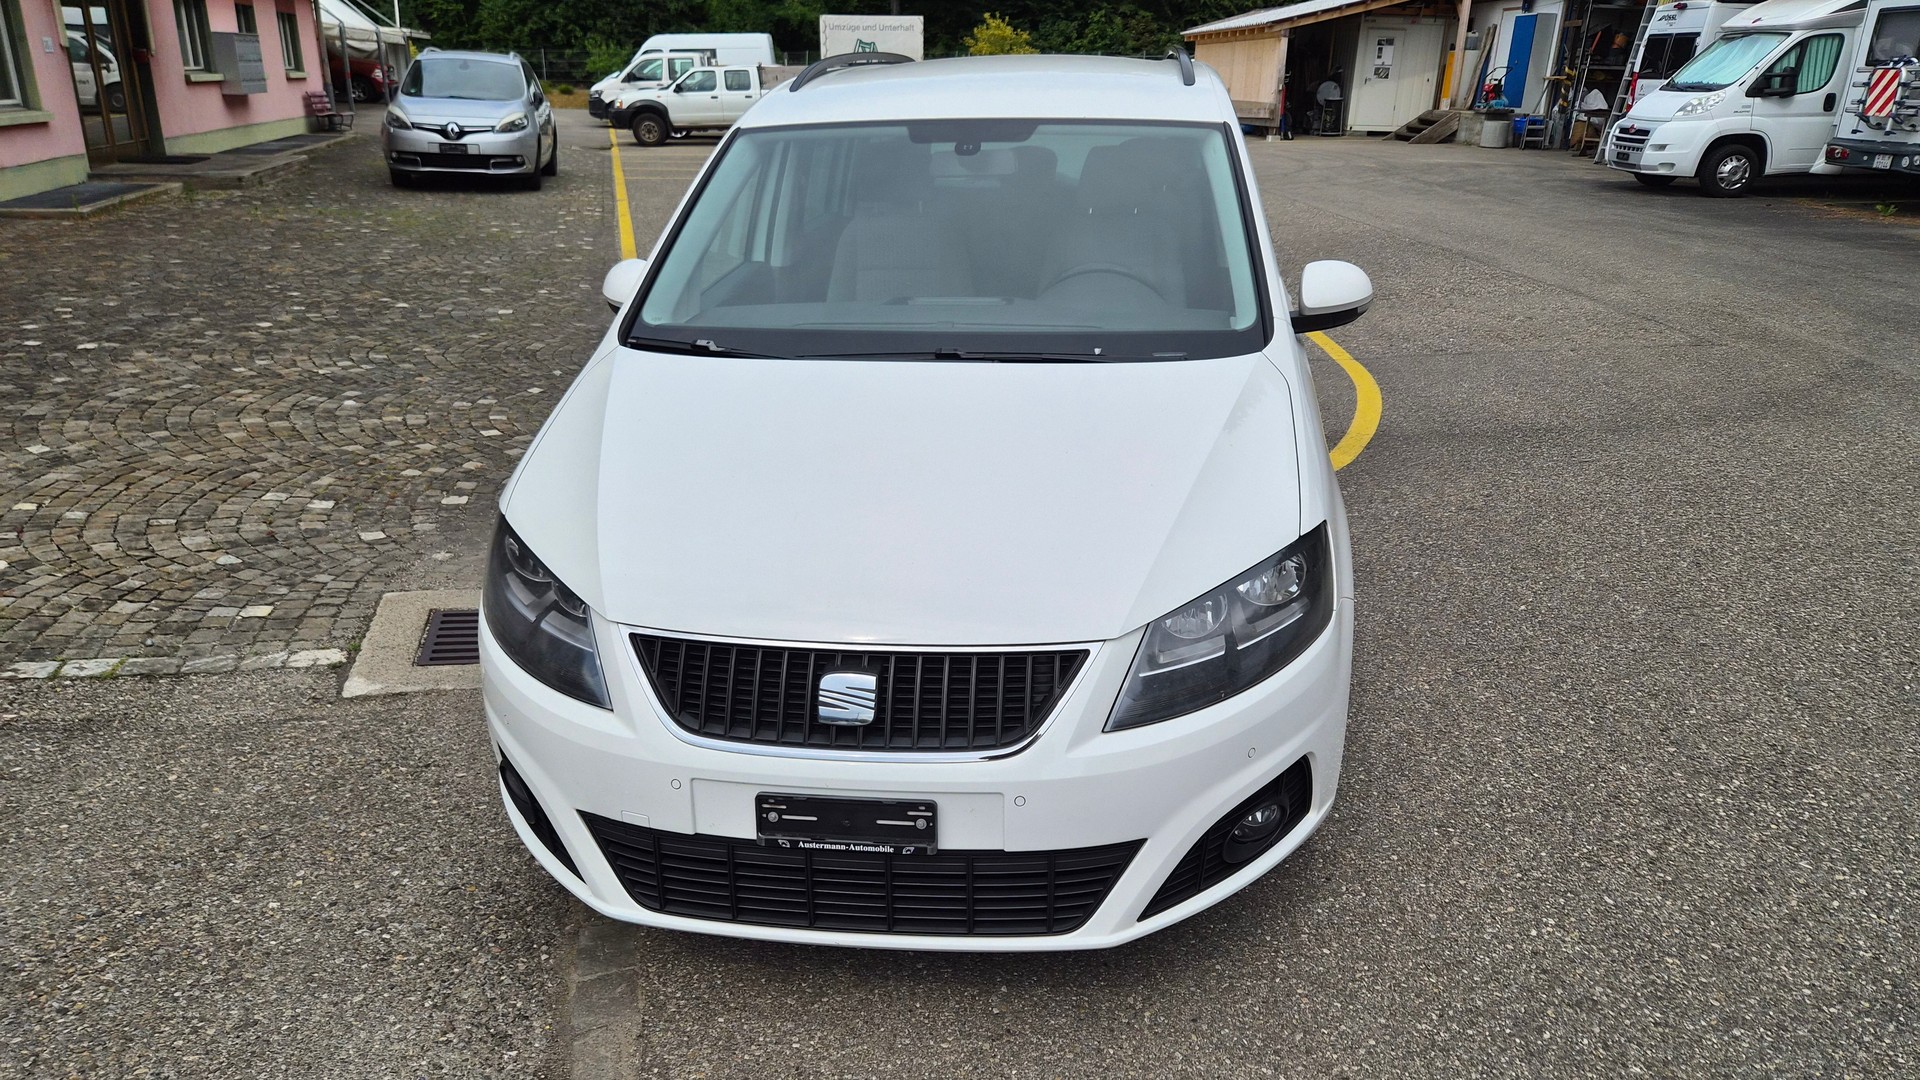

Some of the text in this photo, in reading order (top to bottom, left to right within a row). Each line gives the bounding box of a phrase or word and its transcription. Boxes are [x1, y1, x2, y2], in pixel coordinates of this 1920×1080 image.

[828, 23, 915, 33] Umzüge und Unterhalt
[798, 841, 895, 853] Austermann-Automobile
